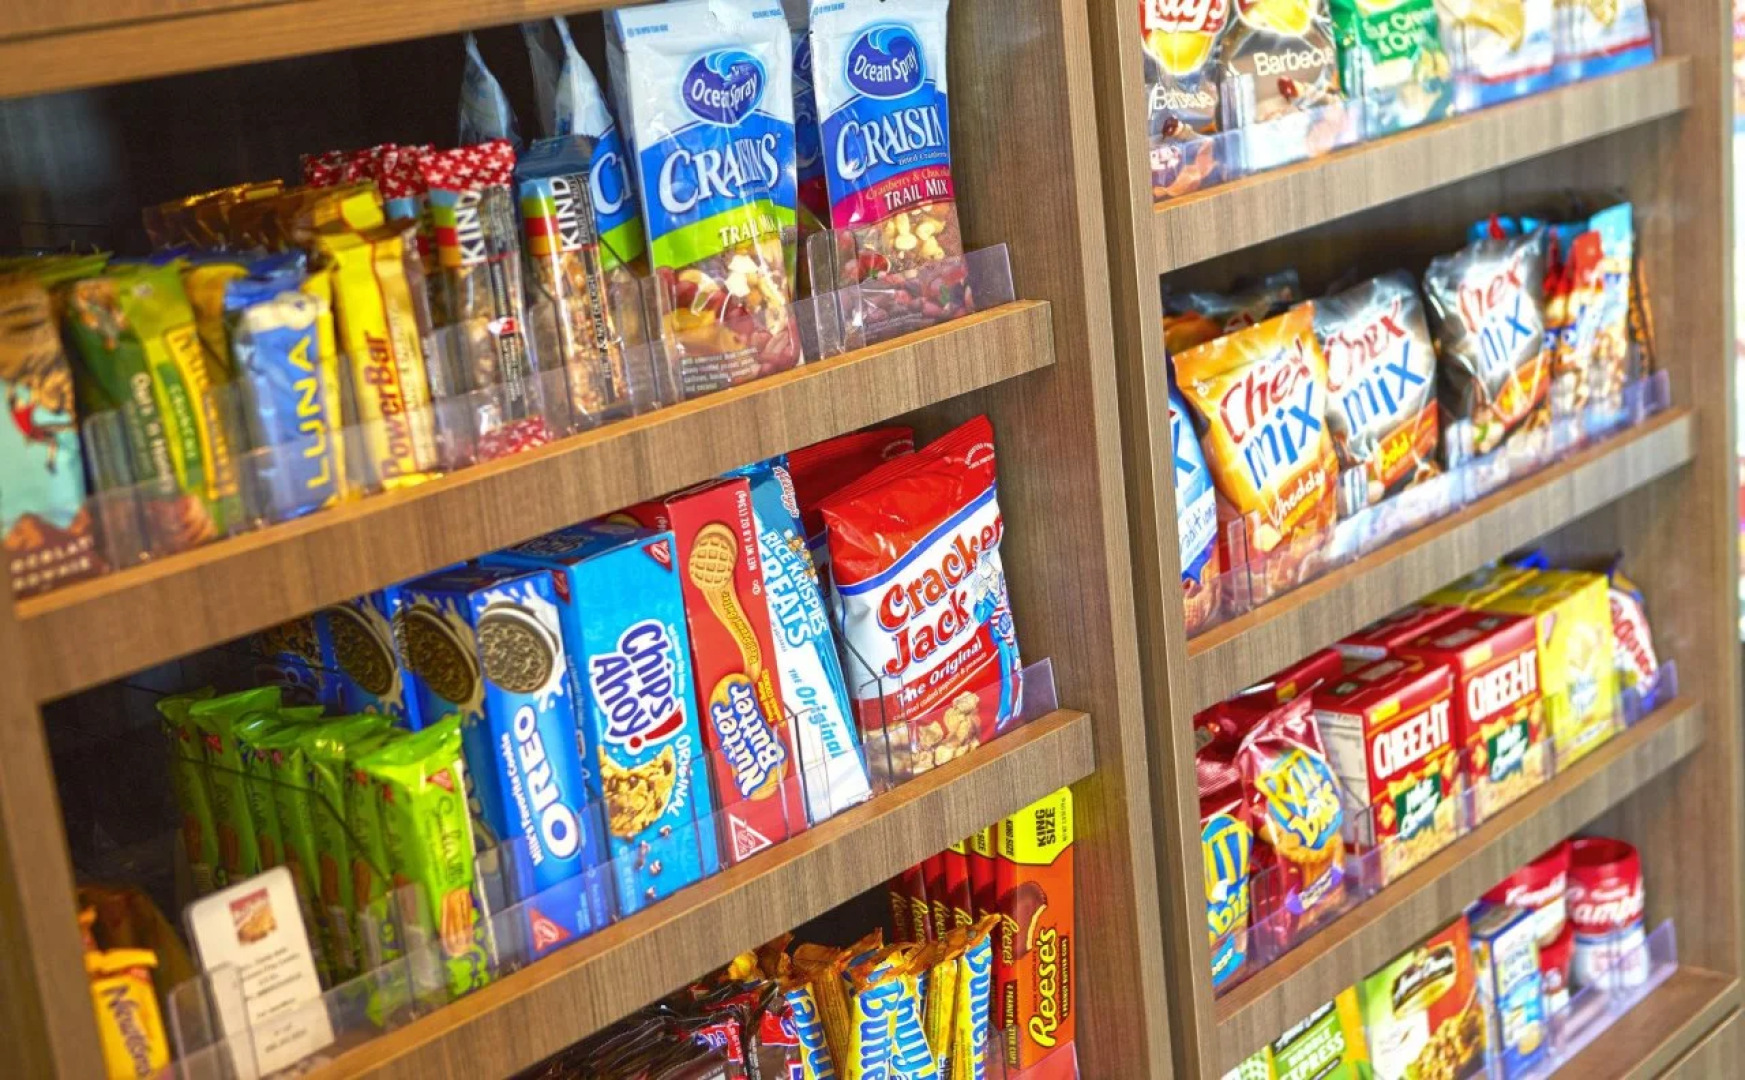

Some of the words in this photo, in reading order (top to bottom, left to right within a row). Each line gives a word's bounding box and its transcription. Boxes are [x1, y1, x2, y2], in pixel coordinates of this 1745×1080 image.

[854, 54, 892, 82] Ocean
[894, 47, 918, 82] Spray
[551, 176, 582, 252] KIND
[884, 184, 923, 211] TRAIL
[925, 177, 949, 198] MIX
[288, 334, 331, 489] LUNA
[363, 330, 406, 481] PowerBar
[1220, 338, 1310, 444] Chex
[1244, 380, 1322, 490] mix
[1342, 339, 1426, 436] mix
[763, 532, 791, 567] RICE
[786, 561, 828, 637] KRISPIES
[876, 512, 1004, 634] Cracker
[620, 622, 674, 721] Chips
[882, 588, 971, 679] Jack
[896, 680, 928, 708] The
[927, 636, 984, 690] Original
[593, 651, 686, 750] Ahoy!
[731, 683, 789, 771] Butter
[795, 684, 847, 759] Original
[1372, 697, 1451, 781] CHEEZ-IT
[512, 704, 580, 860] OREO
[666, 734, 692, 816] ORIGINAL
[712, 703, 761, 798] Nutter
[1034, 808, 1047, 848] KING
[1045, 806, 1056, 845] SIZE
[1029, 928, 1057, 1048] Reese's
